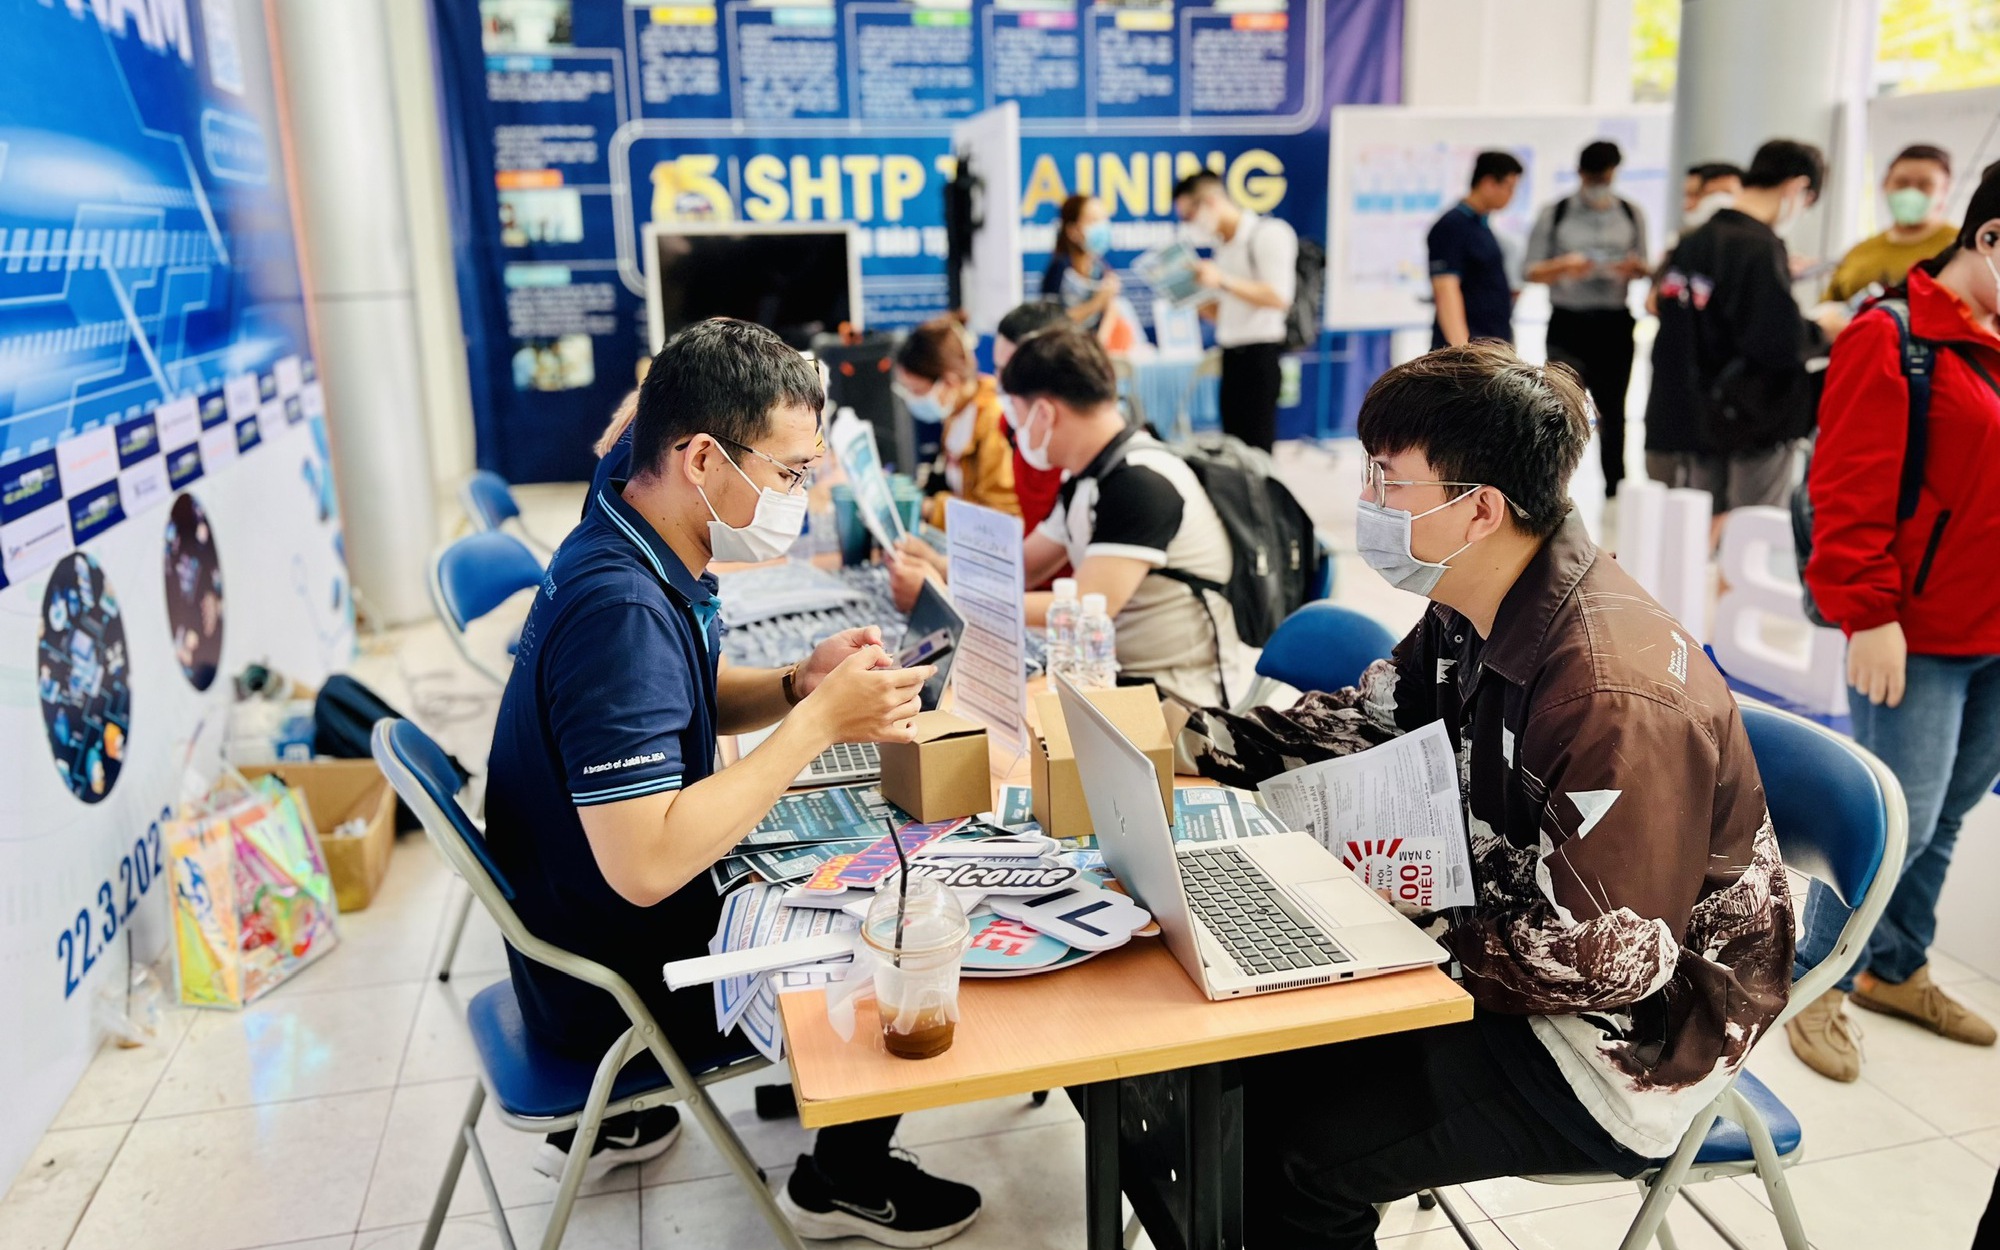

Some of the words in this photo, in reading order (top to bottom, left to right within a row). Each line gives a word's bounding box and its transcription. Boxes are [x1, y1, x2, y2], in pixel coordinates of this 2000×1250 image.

[743, 153, 926, 223] SHTP
[935, 147, 1288, 217] AINIG
[588, 761, 612, 774] branch
[612, 759, 621, 769] of
[1425, 849, 1432, 860] 3
[1400, 864, 1419, 905] 00
[1418, 864, 1435, 907] RIỆU
